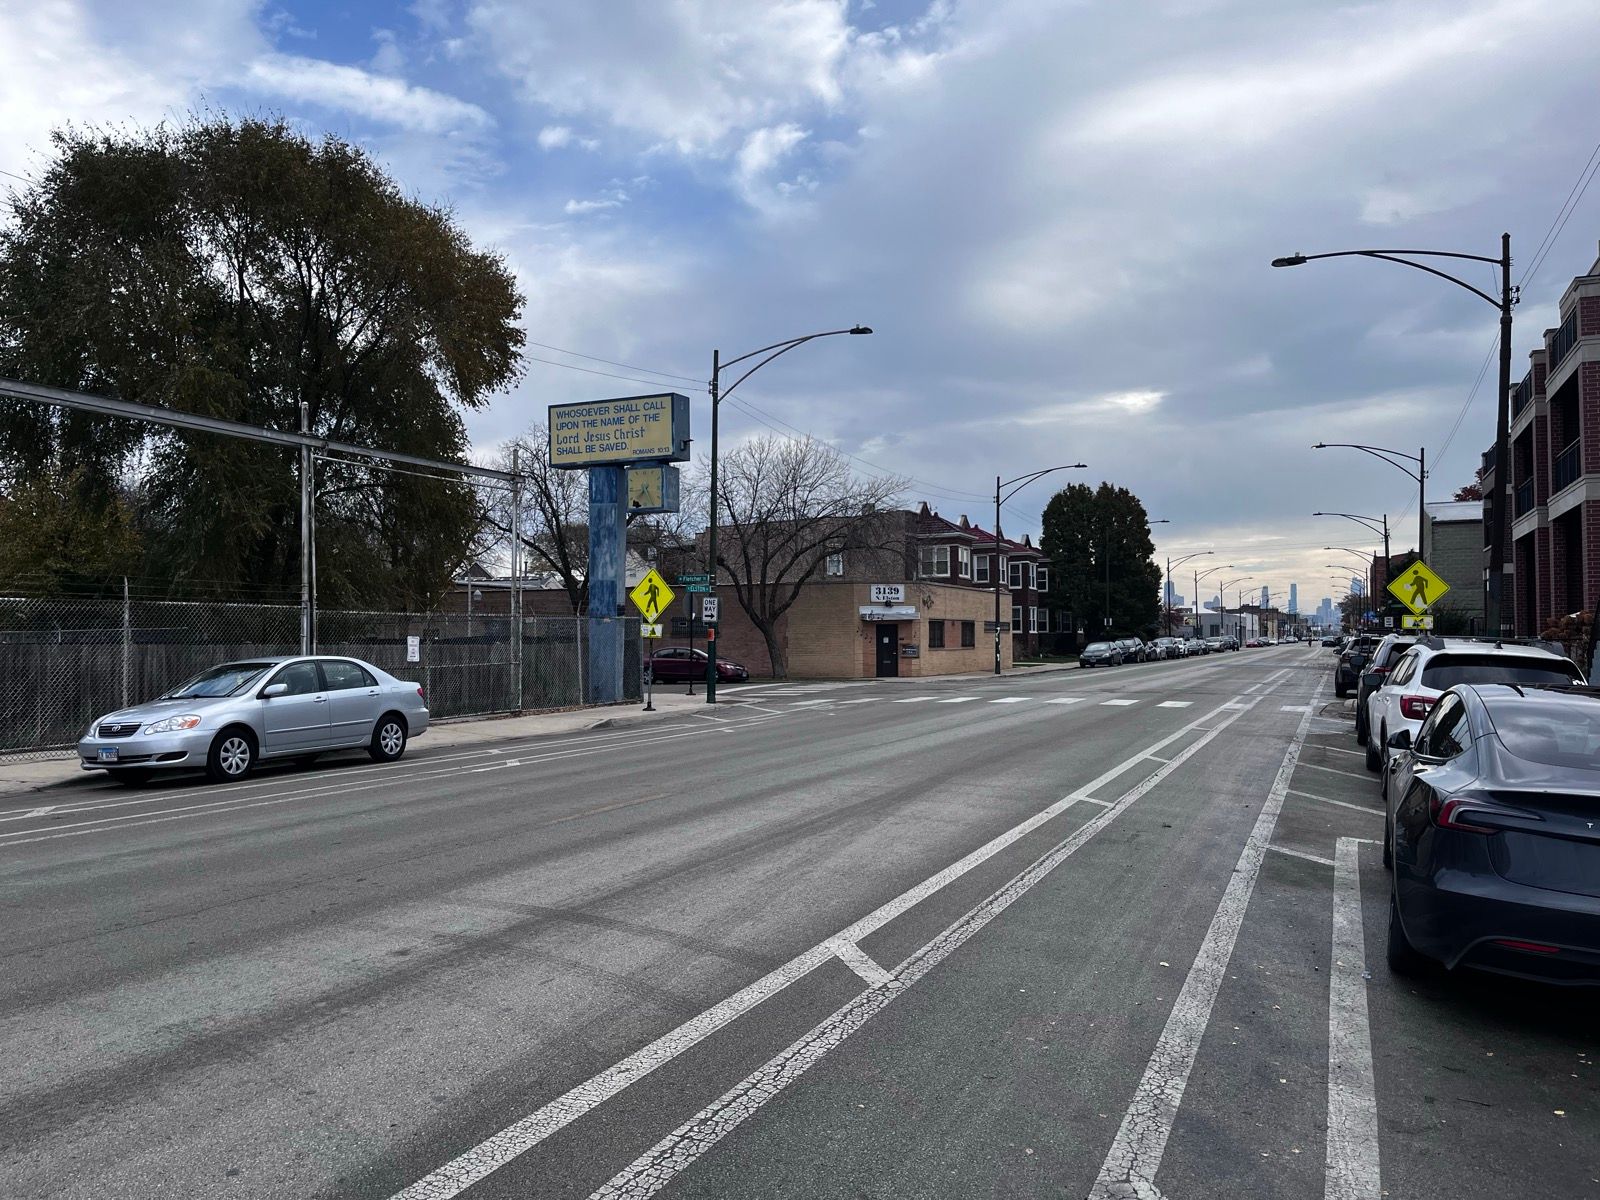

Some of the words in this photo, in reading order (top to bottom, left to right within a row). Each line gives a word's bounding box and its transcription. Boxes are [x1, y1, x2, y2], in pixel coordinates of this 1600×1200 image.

[556, 407, 610, 419] WHOSOEVER
[613, 404, 640, 414] SHALL
[643, 401, 666, 410] CALL
[556, 420, 579, 431] UPON
[582, 419, 598, 428] THE
[601, 416, 625, 427] NAME
[628, 415, 640, 424] OF
[644, 413, 660, 423] THE
[556, 432, 579, 445] Lord
[583, 431, 611, 443] Jesus
[613, 427, 646, 440] Christ
[556, 446, 582, 456] SHALL
[585, 444, 596, 453] BE
[598, 442, 629, 452] SAVED.
[875, 587, 899, 595] 3139
